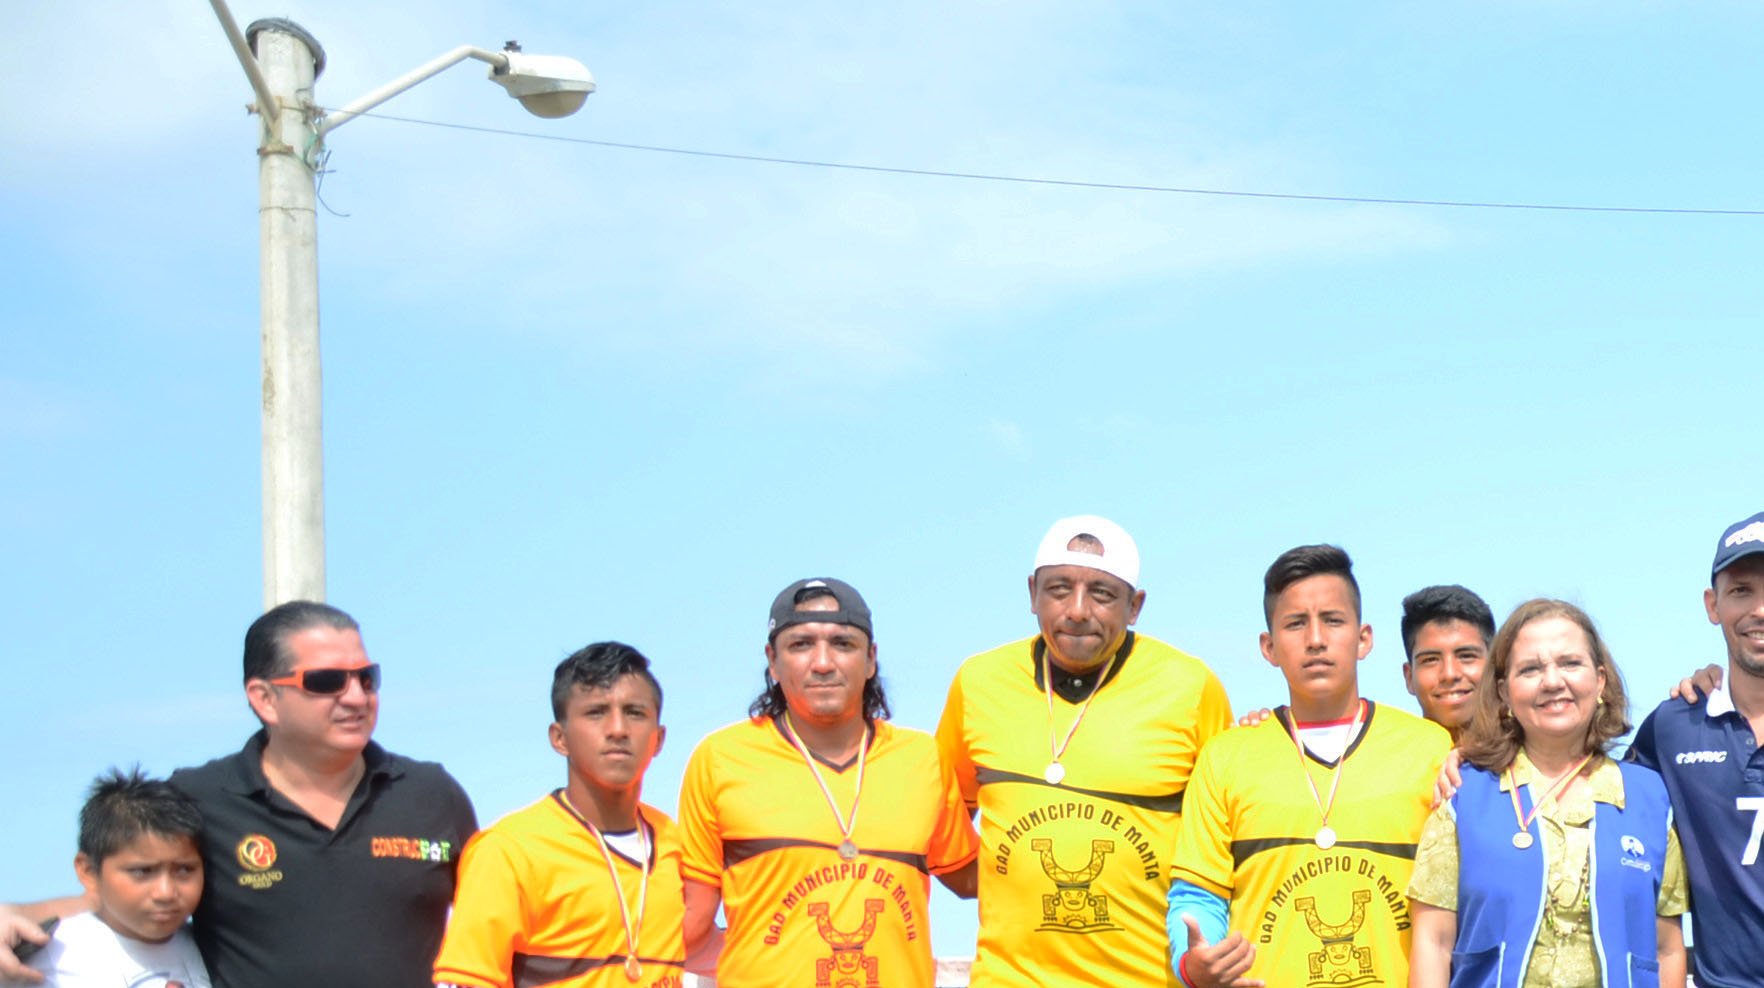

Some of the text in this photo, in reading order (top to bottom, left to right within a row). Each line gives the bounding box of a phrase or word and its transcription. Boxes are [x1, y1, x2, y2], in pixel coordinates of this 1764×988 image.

[996, 803, 1160, 881] GAD MUNICIPIO DE MANTA
[764, 863, 916, 945] GAD MUNICIPIO DE MANTA
[1260, 856, 1411, 944] GAD MUNICIPIO DE MANTA
